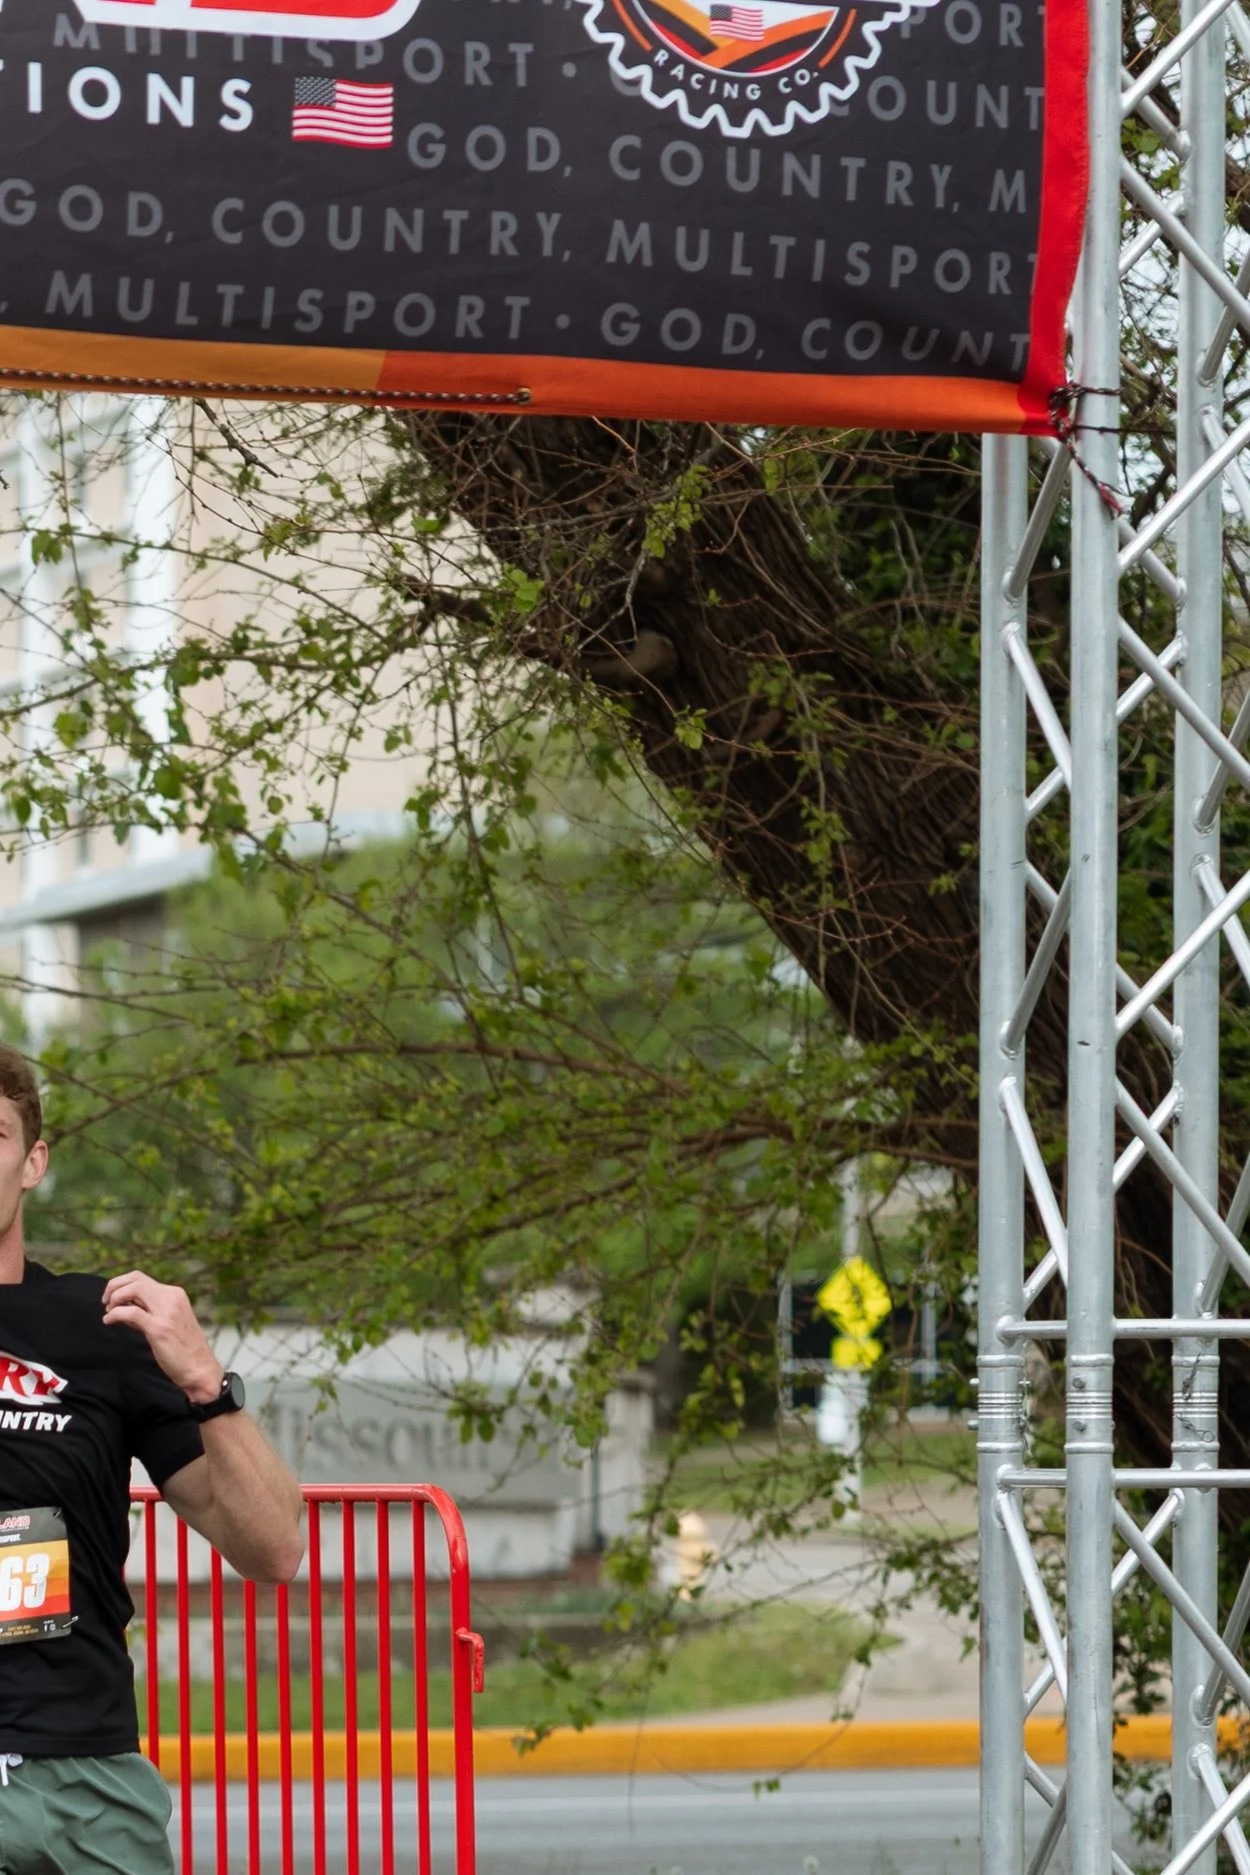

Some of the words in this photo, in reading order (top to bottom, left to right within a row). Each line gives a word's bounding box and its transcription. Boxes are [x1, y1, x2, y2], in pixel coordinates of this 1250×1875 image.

[654, 49, 761, 100] RACING
[830, 75, 1044, 130] OUNT
[407, 123, 572, 178] GOD,
[609, 134, 959, 213] COUNTRY,
[211, 197, 571, 262] COUNTRY,
[46, 271, 531, 339] MULTISPORT
[601, 303, 763, 359] GOD,
[801, 317, 1030, 372] COUNT
